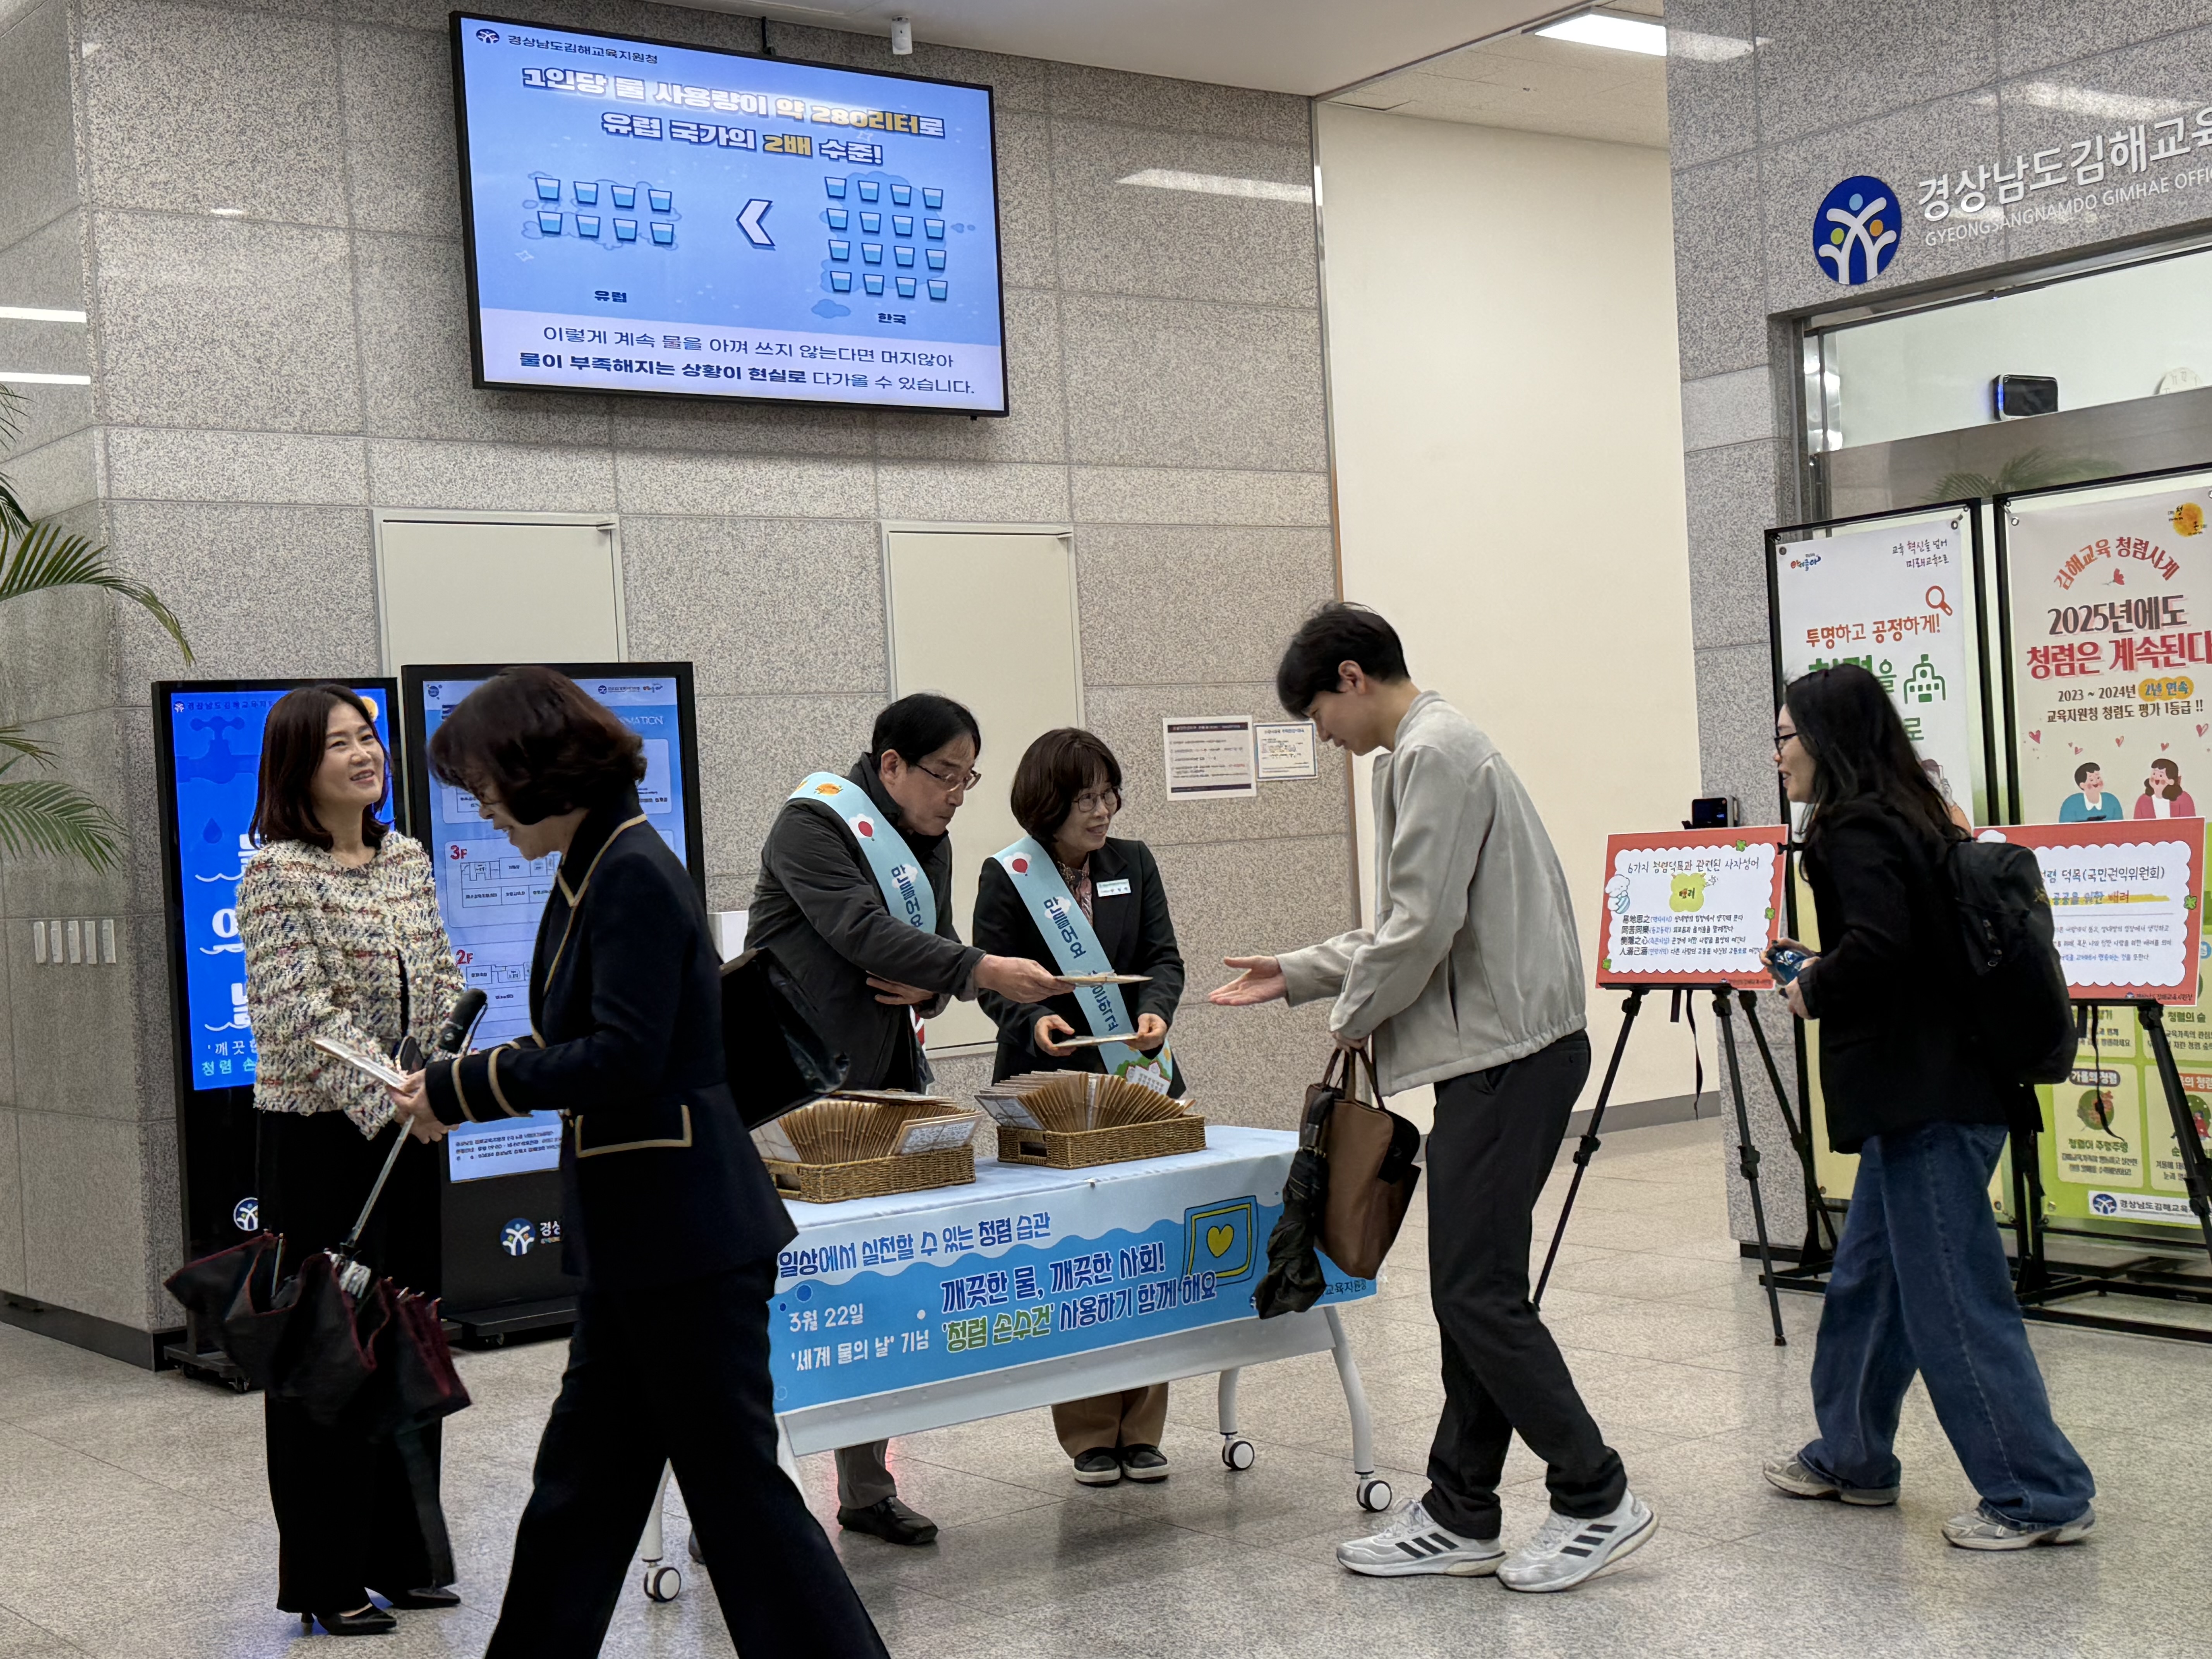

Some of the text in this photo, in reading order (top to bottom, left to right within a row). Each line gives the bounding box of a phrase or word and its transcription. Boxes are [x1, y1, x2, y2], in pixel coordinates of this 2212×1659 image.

[508, 35, 657, 64] 경상남도김해교육지원청
[522, 68, 945, 139] 1인당 물 사용량이 약 280리터로
[601, 112, 883, 166] 유럽 국가의 2배 수준!
[1918, 107, 2212, 222] 경상남도김해교육
[1925, 195, 2097, 246] GYEONGSANGNAMDO
[2103, 177, 2169, 206] GIMHAE
[594, 290, 627, 303] 유럽
[878, 313, 906, 325] 한국
[544, 326, 954, 368] 이렇게 계속 물을 아껴 쓰지 않는다면 머지않아
[520, 352, 974, 394] 물이 부족해지는 상황이 현실로 다가올 수 있습니다.
[1892, 543, 1904, 556] 교육
[1907, 540, 1930, 554] 혁신을
[1906, 554, 1949, 568] 미래교육으로
[2054, 537, 2179, 591] 김해교육 청렴사계
[1806, 613, 1940, 649] 투명하고 공정하게!
[2047, 595, 2188, 635] 2025년에도
[2027, 630, 2212, 680] 청렴은 계속된다
[2058, 689, 2083, 702] 2023
[2098, 685, 2136, 699] 2024년
[2145, 683, 2162, 696] 2년
[2166, 681, 2188, 694] 연속
[2047, 707, 2098, 723] 교육지원청
[2102, 705, 2135, 720] 청렴도
[2138, 702, 2160, 718] 평가
[450, 845, 467, 860] 3F
[1628, 861, 1649, 874] 6가지
[1696, 859, 1721, 872] 관련된
[1725, 857, 1759, 870] 사자성어
[2062, 866, 2164, 883] 덕목(국민권익위원회)
[2108, 890, 2129, 903] 배려
[1043, 897, 1086, 959] 만들어요
[456, 949, 473, 965] 2F
[779, 1212, 1050, 1278] 일상에서 실천할 수 있는 청렴 습관
[941, 1242, 1165, 1313] 깨끗한 물, 깨끗한 사회!
[789, 1304, 864, 1332] 3월 22일
[942, 1271, 1216, 1353] '청렴 손수건' 사용하기 함께 해요
[791, 1330, 929, 1371] '세계 물의 날' 기념
